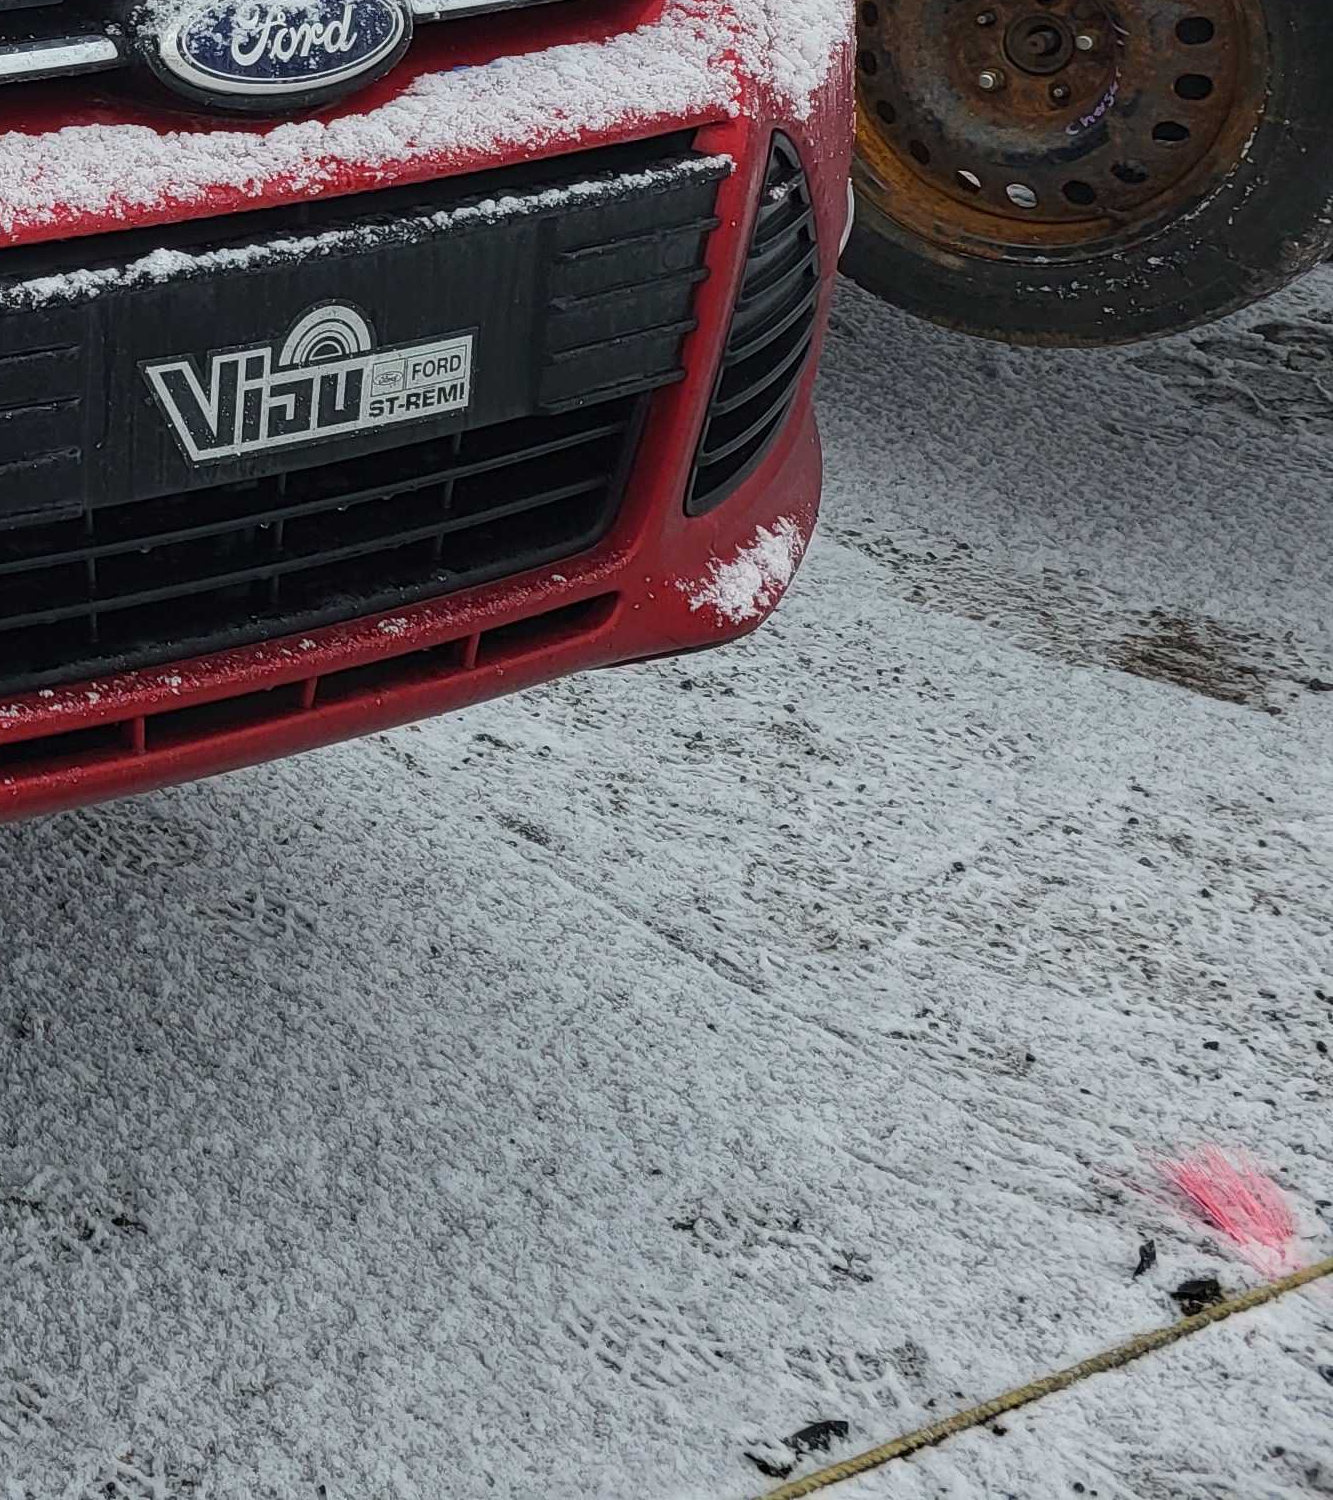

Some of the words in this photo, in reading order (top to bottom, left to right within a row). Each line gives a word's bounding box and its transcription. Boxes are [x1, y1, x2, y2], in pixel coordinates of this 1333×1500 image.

[231, 0, 359, 67] Ford
[411, 354, 462, 381] FORD
[369, 382, 465, 418] ST-REMI
